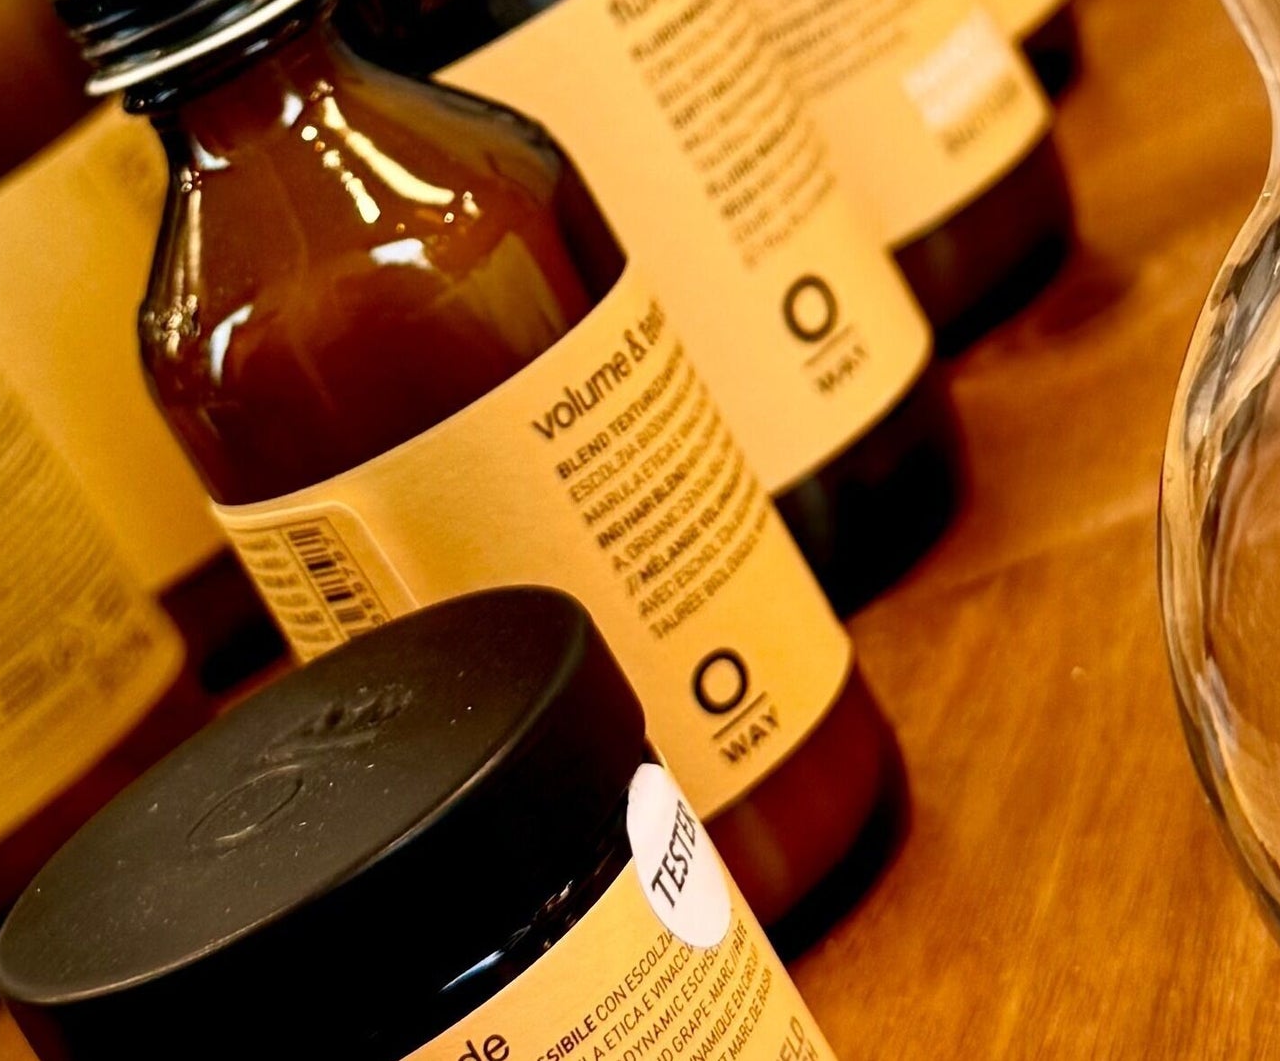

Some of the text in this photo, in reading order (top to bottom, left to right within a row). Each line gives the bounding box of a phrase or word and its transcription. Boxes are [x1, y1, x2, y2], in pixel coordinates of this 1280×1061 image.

[783, 274, 838, 343] O
[532, 351, 632, 440] volume
[624, 327, 648, 363] &
[556, 431, 611, 480] BLEND
[692, 646, 749, 715] O
[720, 703, 780, 764] WAY
[650, 799, 698, 908] TESTER
[595, 984, 627, 1021] CON
[603, 1006, 645, 1050] ETICA
[641, 992, 654, 1012] E
[616, 995, 684, 1060] DYNAMIC
[731, 984, 746, 1010] EN
[728, 1016, 754, 1060] MARC
[748, 998, 762, 1024] DE
